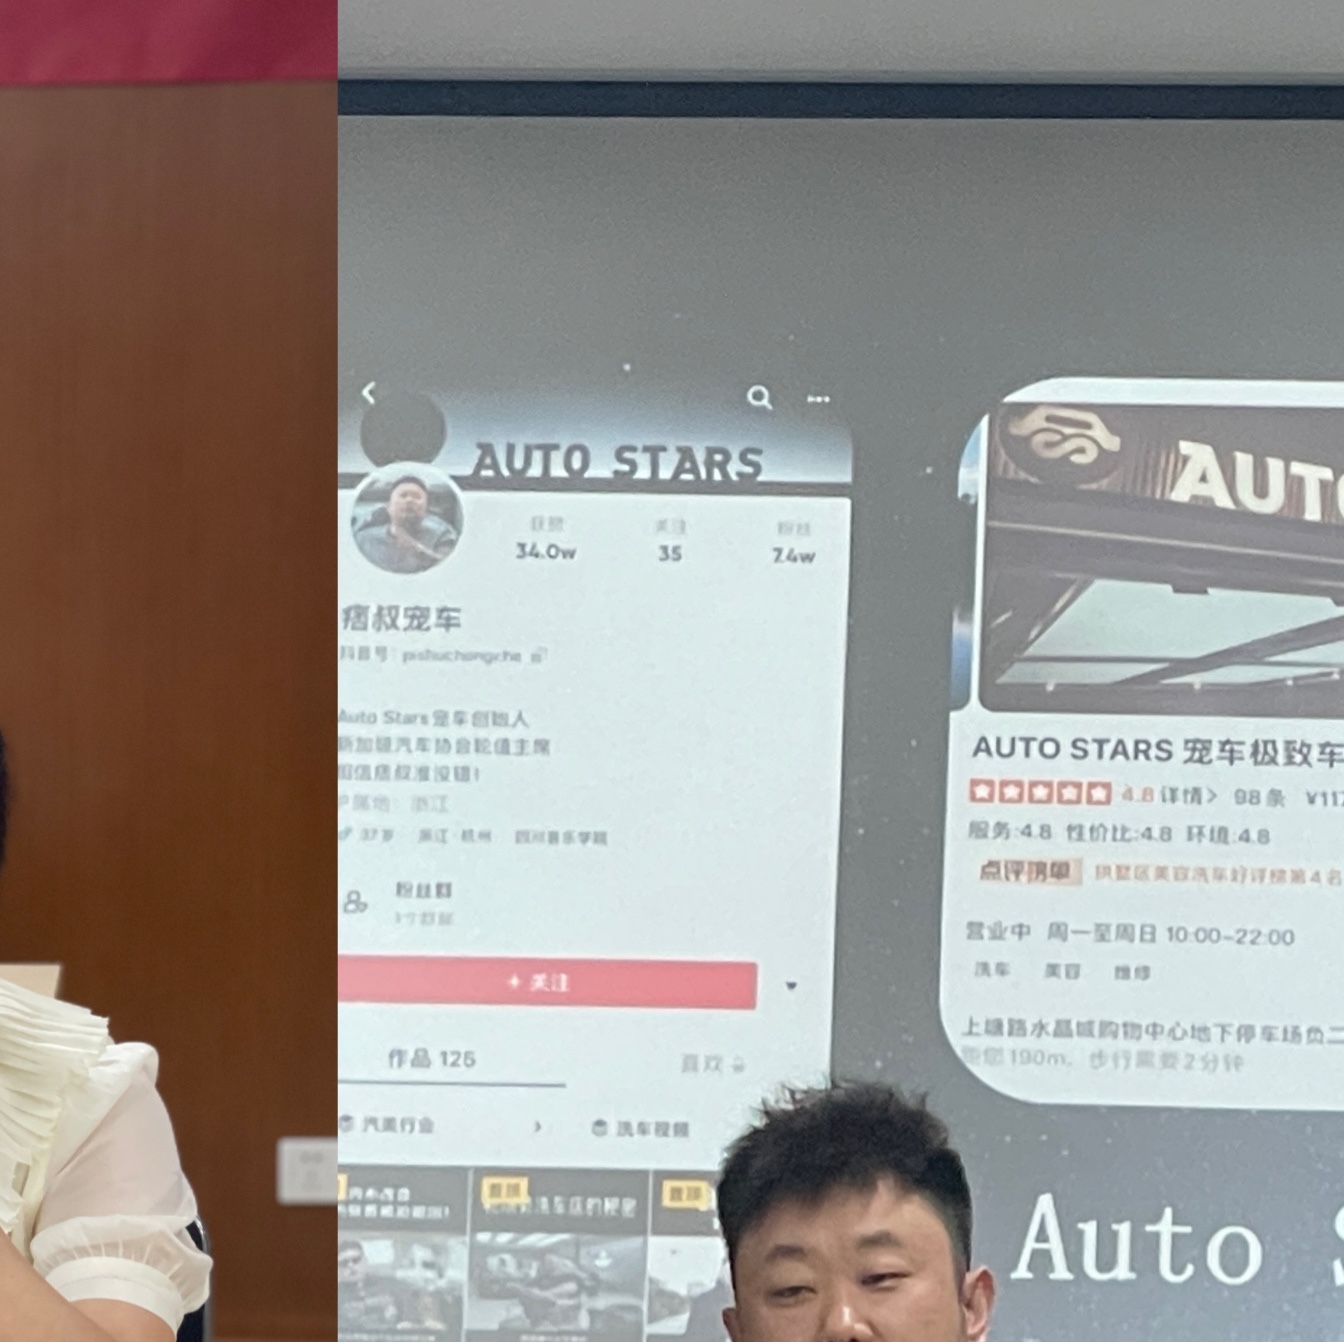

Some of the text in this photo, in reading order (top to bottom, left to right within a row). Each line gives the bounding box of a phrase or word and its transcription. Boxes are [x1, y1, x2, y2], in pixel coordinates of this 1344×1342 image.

[472, 442, 765, 482] AUTO STARS
[1169, 440, 1344, 522] AUT
[658, 544, 683, 562] 35
[972, 736, 1061, 760] AUTO
[1070, 737, 1173, 762] STARS
[1047, 921, 1157, 944] 周一至周日
[388, 1048, 432, 1070] 作品
[1010, 1192, 1263, 1285] Auto
